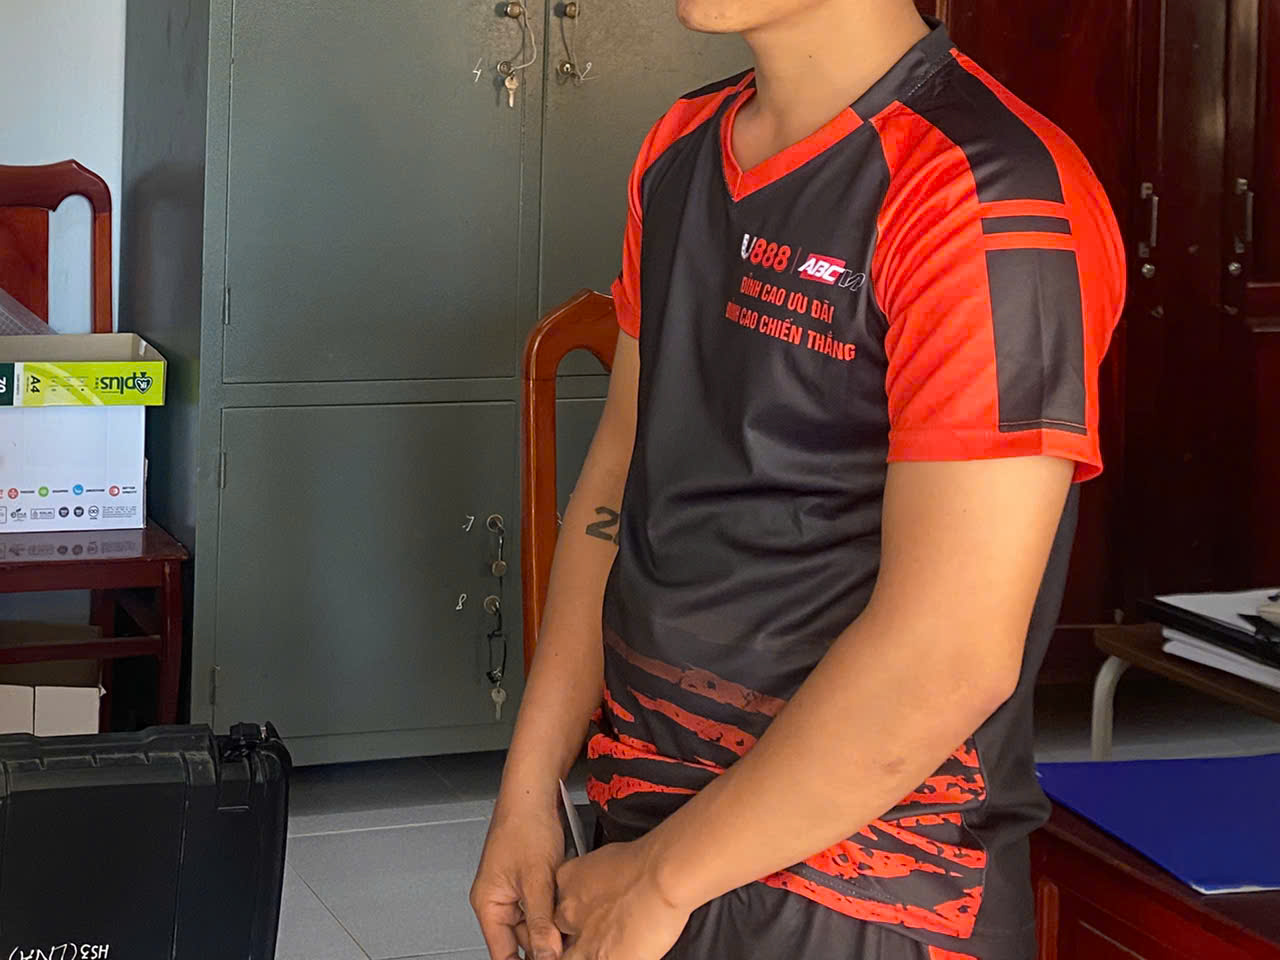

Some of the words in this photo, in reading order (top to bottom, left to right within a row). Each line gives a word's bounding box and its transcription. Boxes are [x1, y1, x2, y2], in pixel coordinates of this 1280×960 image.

[761, 283, 786, 306] CAO
[787, 291, 808, 314] ƯU
[740, 307, 758, 329] CAO
[759, 315, 803, 345] CHIẾN
[807, 330, 857, 361] THẮNG
[30, 375, 41, 393] A4
[100, 372, 136, 394] plus
